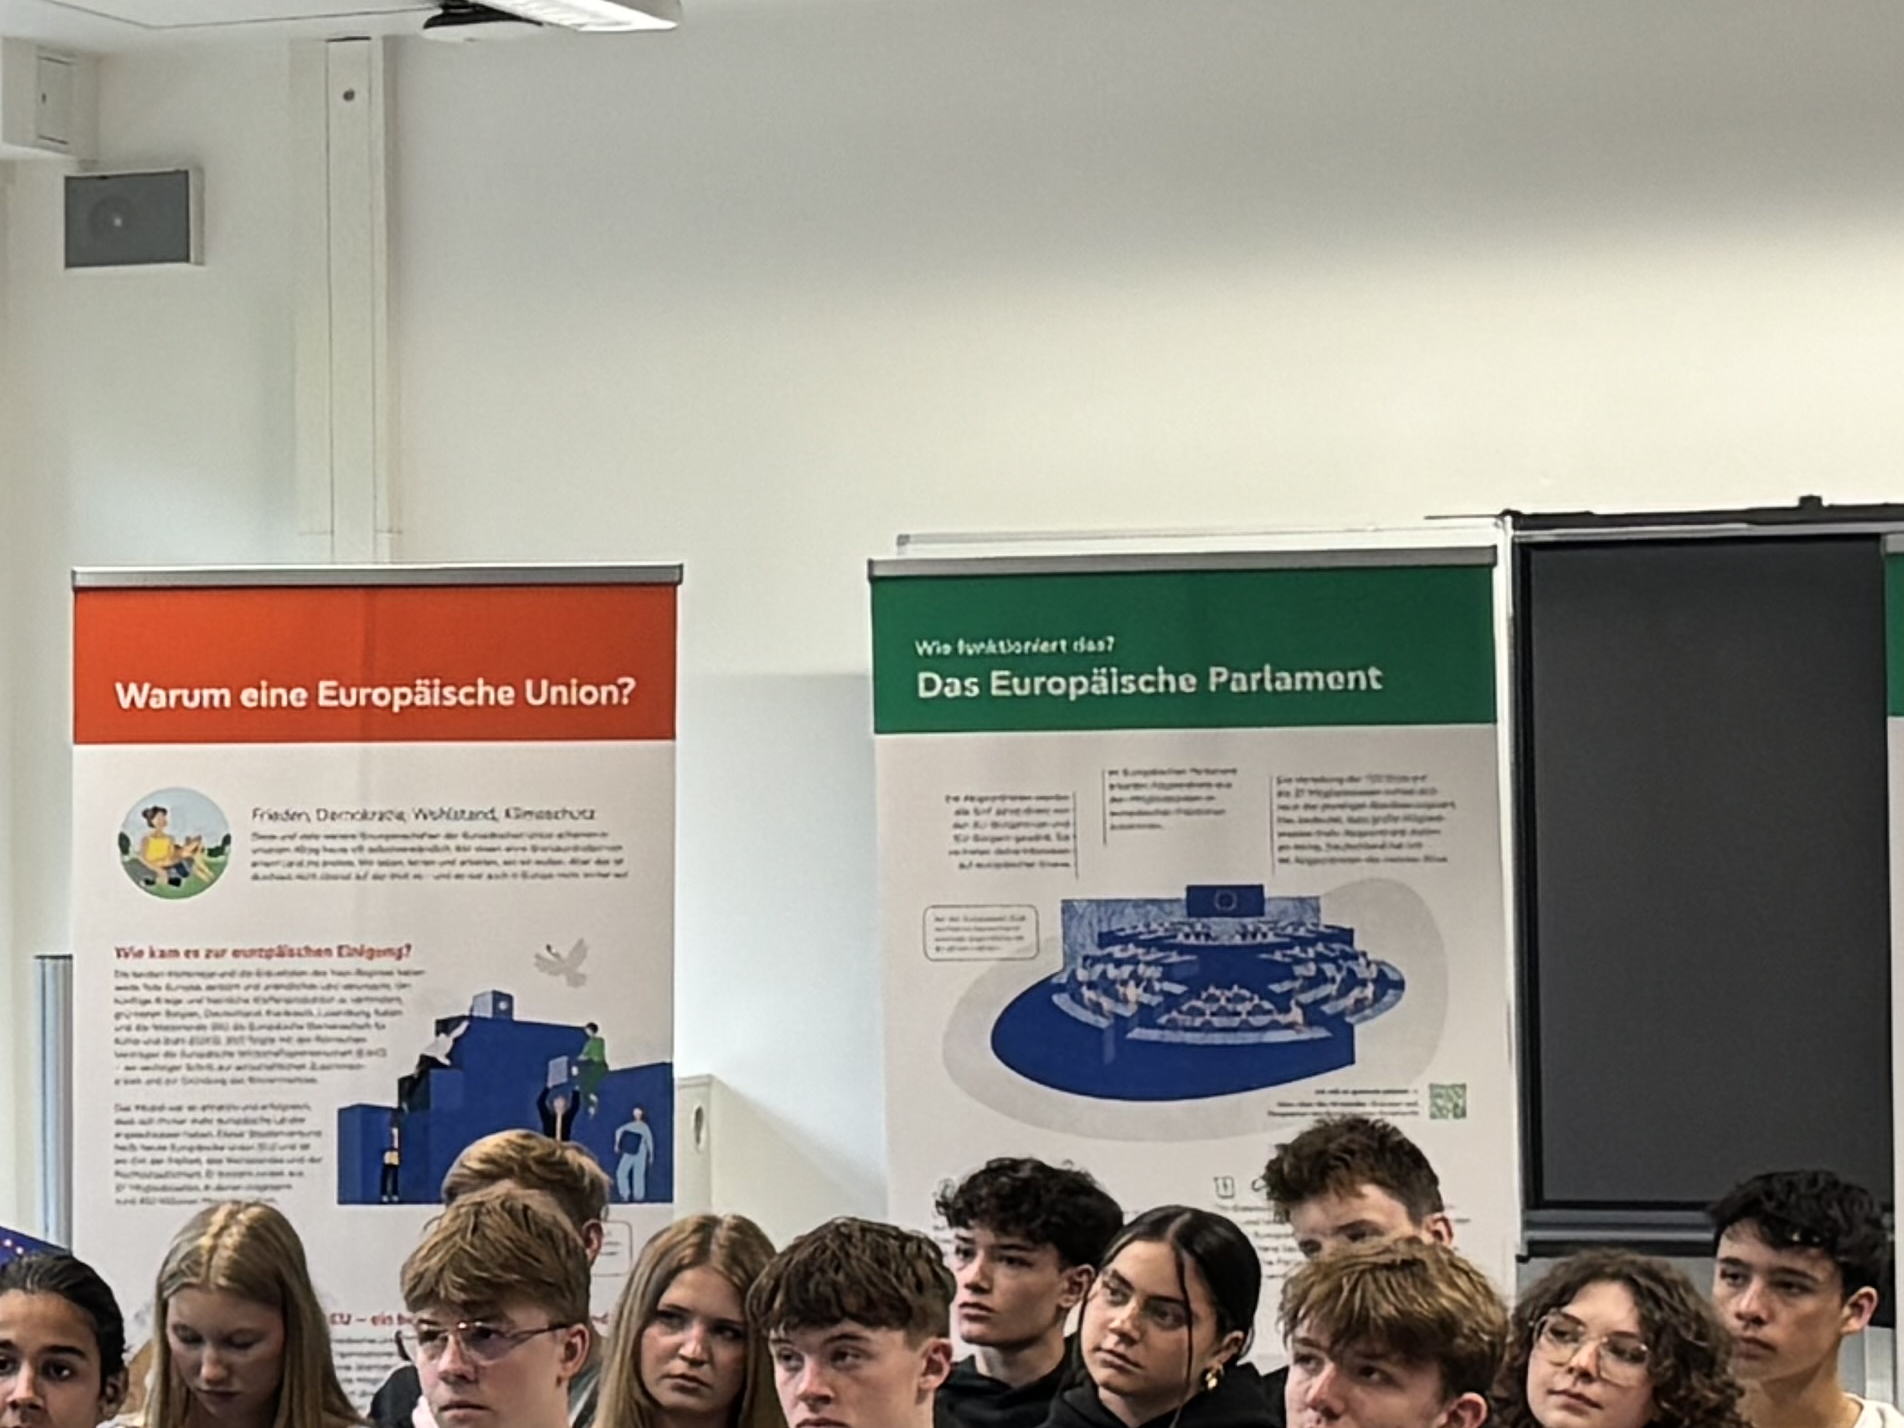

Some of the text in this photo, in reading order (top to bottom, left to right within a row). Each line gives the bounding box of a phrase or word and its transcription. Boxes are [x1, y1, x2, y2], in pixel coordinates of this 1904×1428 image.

[915, 635, 1115, 656] Wie funktioniert das?
[115, 677, 636, 713] Warum eine Europäische Union?
[917, 663, 1383, 702] Das Europäische Parlament
[149, 945, 180, 959] kam
